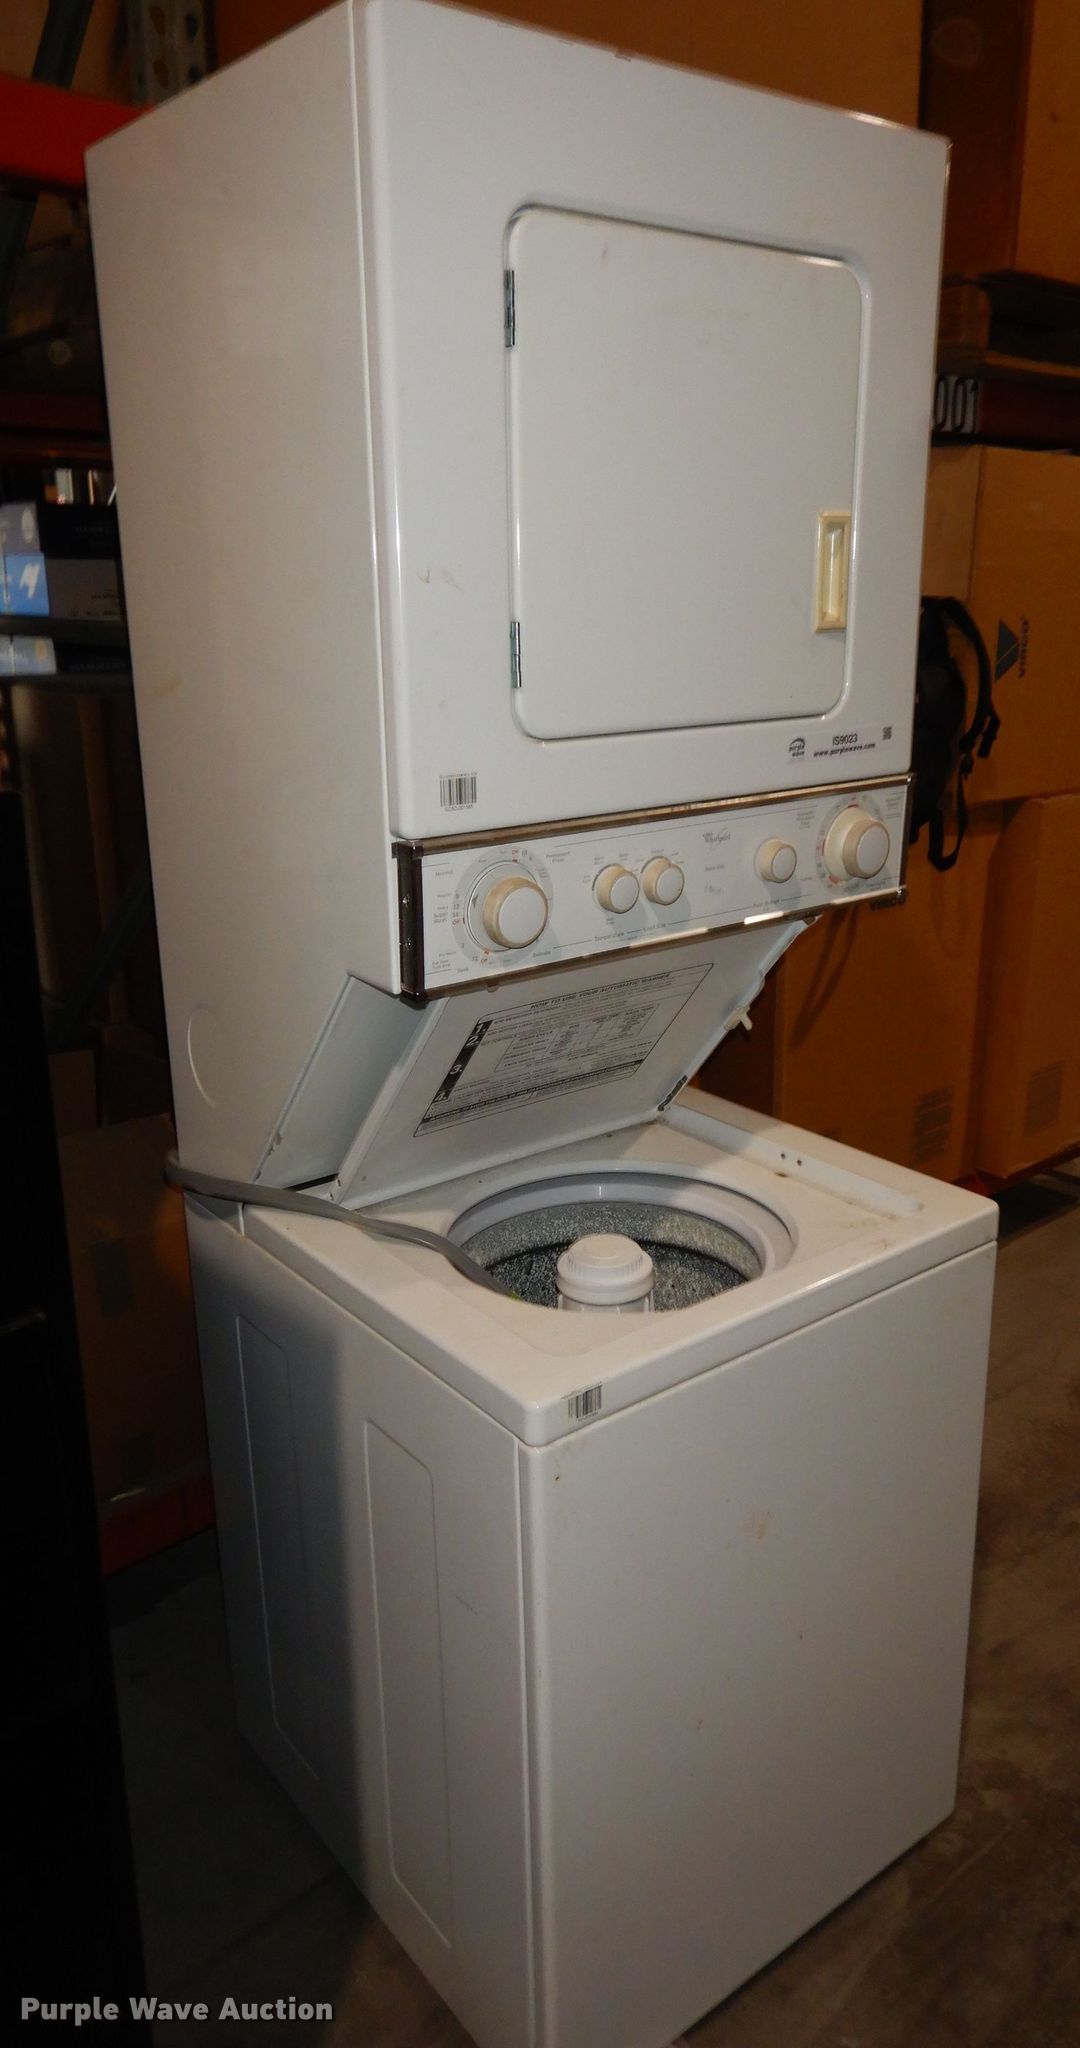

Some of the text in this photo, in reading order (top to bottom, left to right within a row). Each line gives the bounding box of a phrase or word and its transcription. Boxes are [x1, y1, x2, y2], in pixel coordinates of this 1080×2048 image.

[934, 375, 979, 433] 001
[832, 733, 858, 746] IS9023
[814, 743, 876, 758] www.purplewave.com
